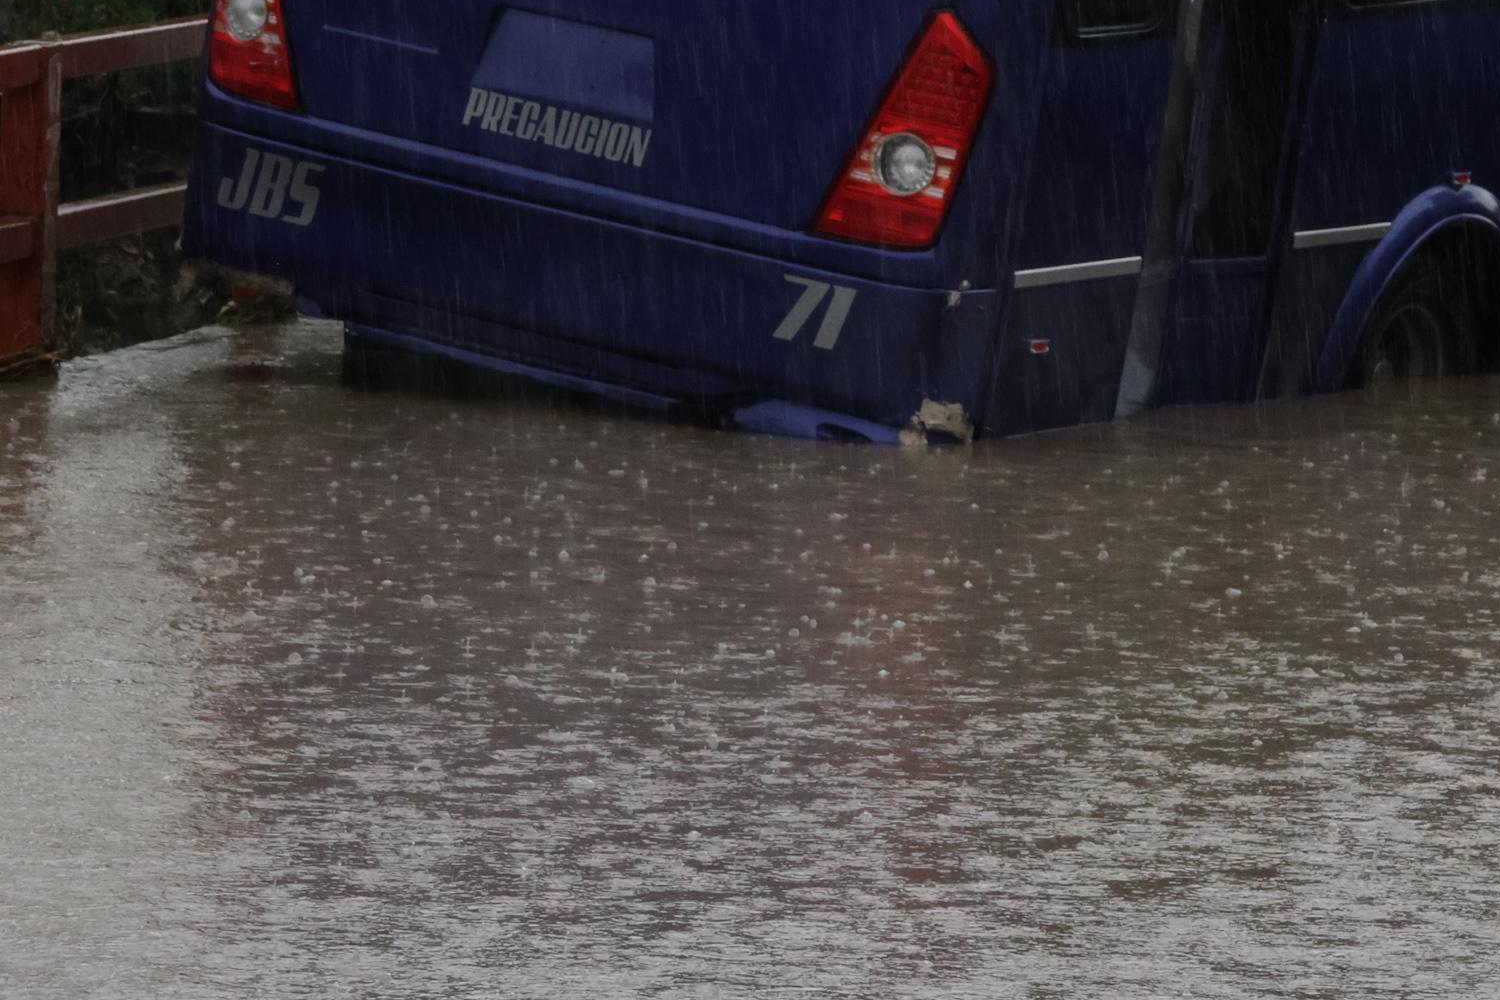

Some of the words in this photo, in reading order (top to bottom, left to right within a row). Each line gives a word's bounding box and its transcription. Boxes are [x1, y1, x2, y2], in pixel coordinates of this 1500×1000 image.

[461, 87, 653, 169] PRECAUCION
[217, 147, 327, 227] JBS
[772, 273, 858, 351] 71
